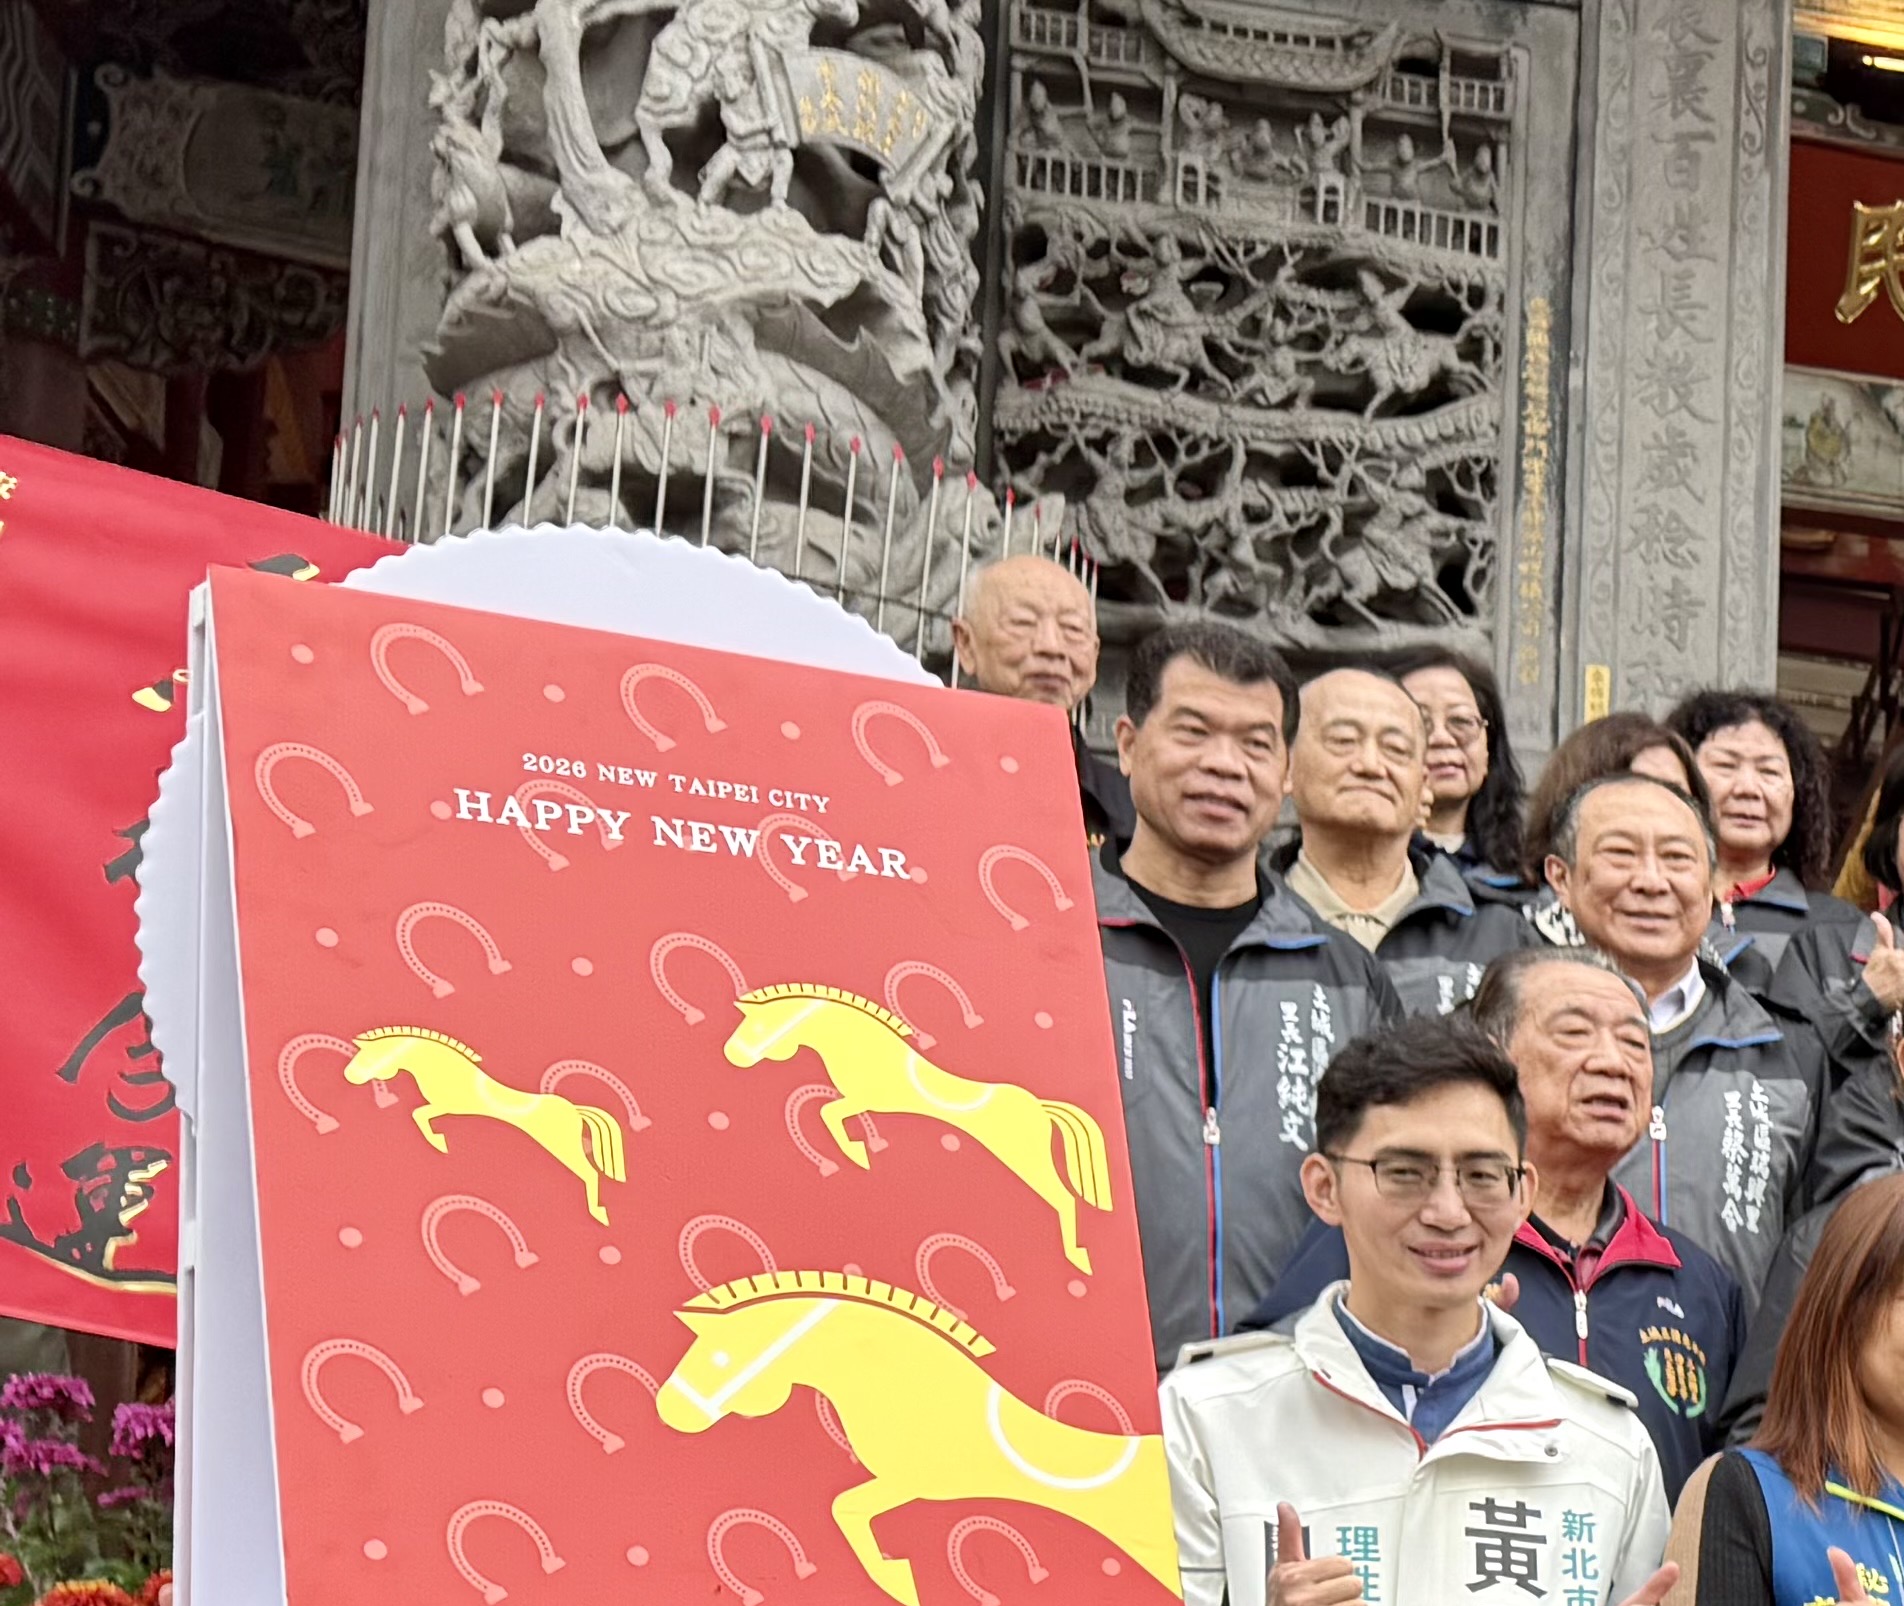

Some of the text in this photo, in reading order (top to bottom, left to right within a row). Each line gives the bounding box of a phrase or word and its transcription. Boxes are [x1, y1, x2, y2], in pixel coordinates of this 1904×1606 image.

[522, 752, 831, 813] 2026 NEW TAIPEI CITY
[453, 787, 912, 881] HAPPY NEW YEAR
